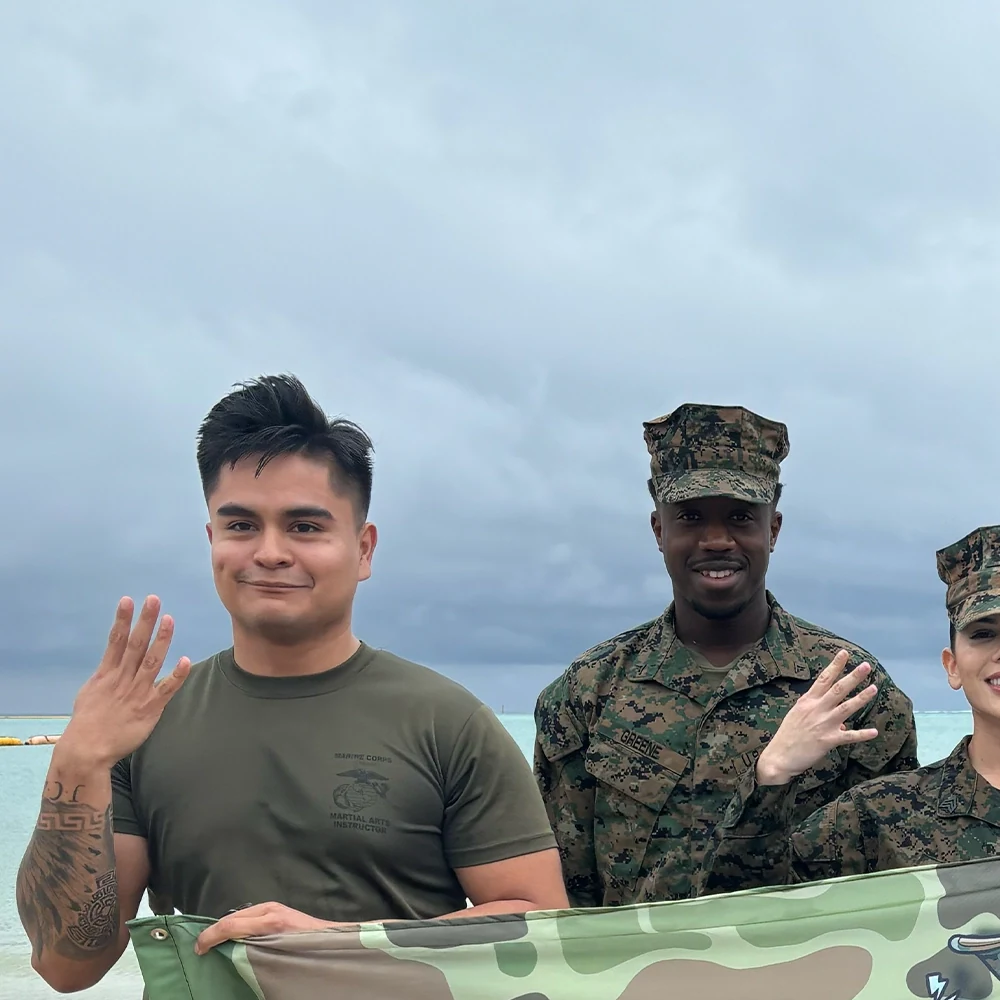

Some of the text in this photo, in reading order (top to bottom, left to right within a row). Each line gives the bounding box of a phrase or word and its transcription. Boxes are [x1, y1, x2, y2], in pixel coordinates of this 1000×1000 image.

[620, 729, 663, 760] GREENE
[334, 752, 392, 764] MARINE CORPS
[330, 812, 391, 827] MARTIAL ARTS
[333, 821, 388, 834] INSTRUCTOR
